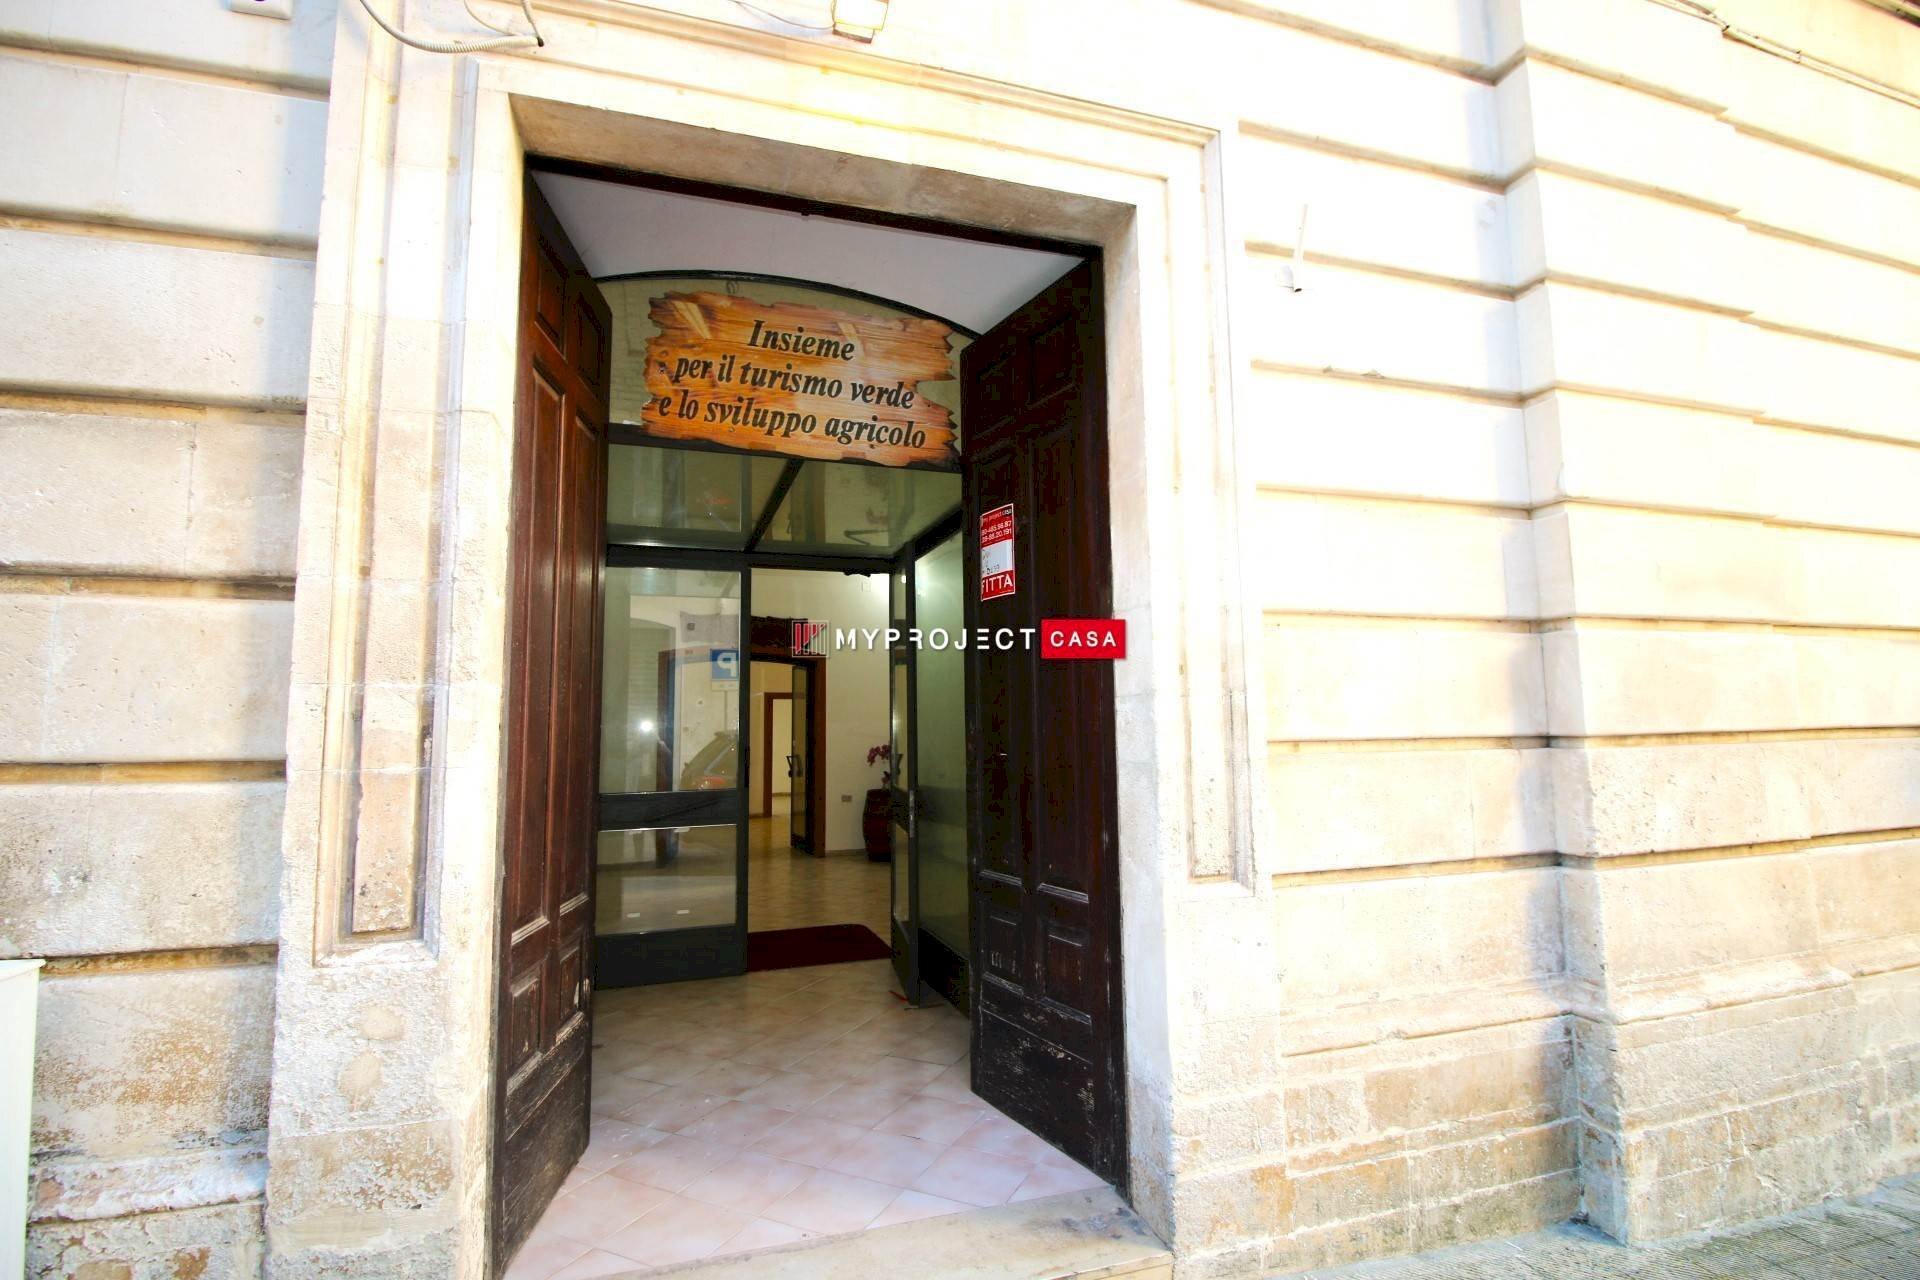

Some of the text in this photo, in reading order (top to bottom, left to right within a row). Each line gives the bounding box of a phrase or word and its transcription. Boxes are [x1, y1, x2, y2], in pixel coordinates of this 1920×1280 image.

[747, 319, 856, 361] Insieme
[673, 354, 915, 410] per il turismo verde
[658, 389, 926, 449] e lo sviluppo agricolo
